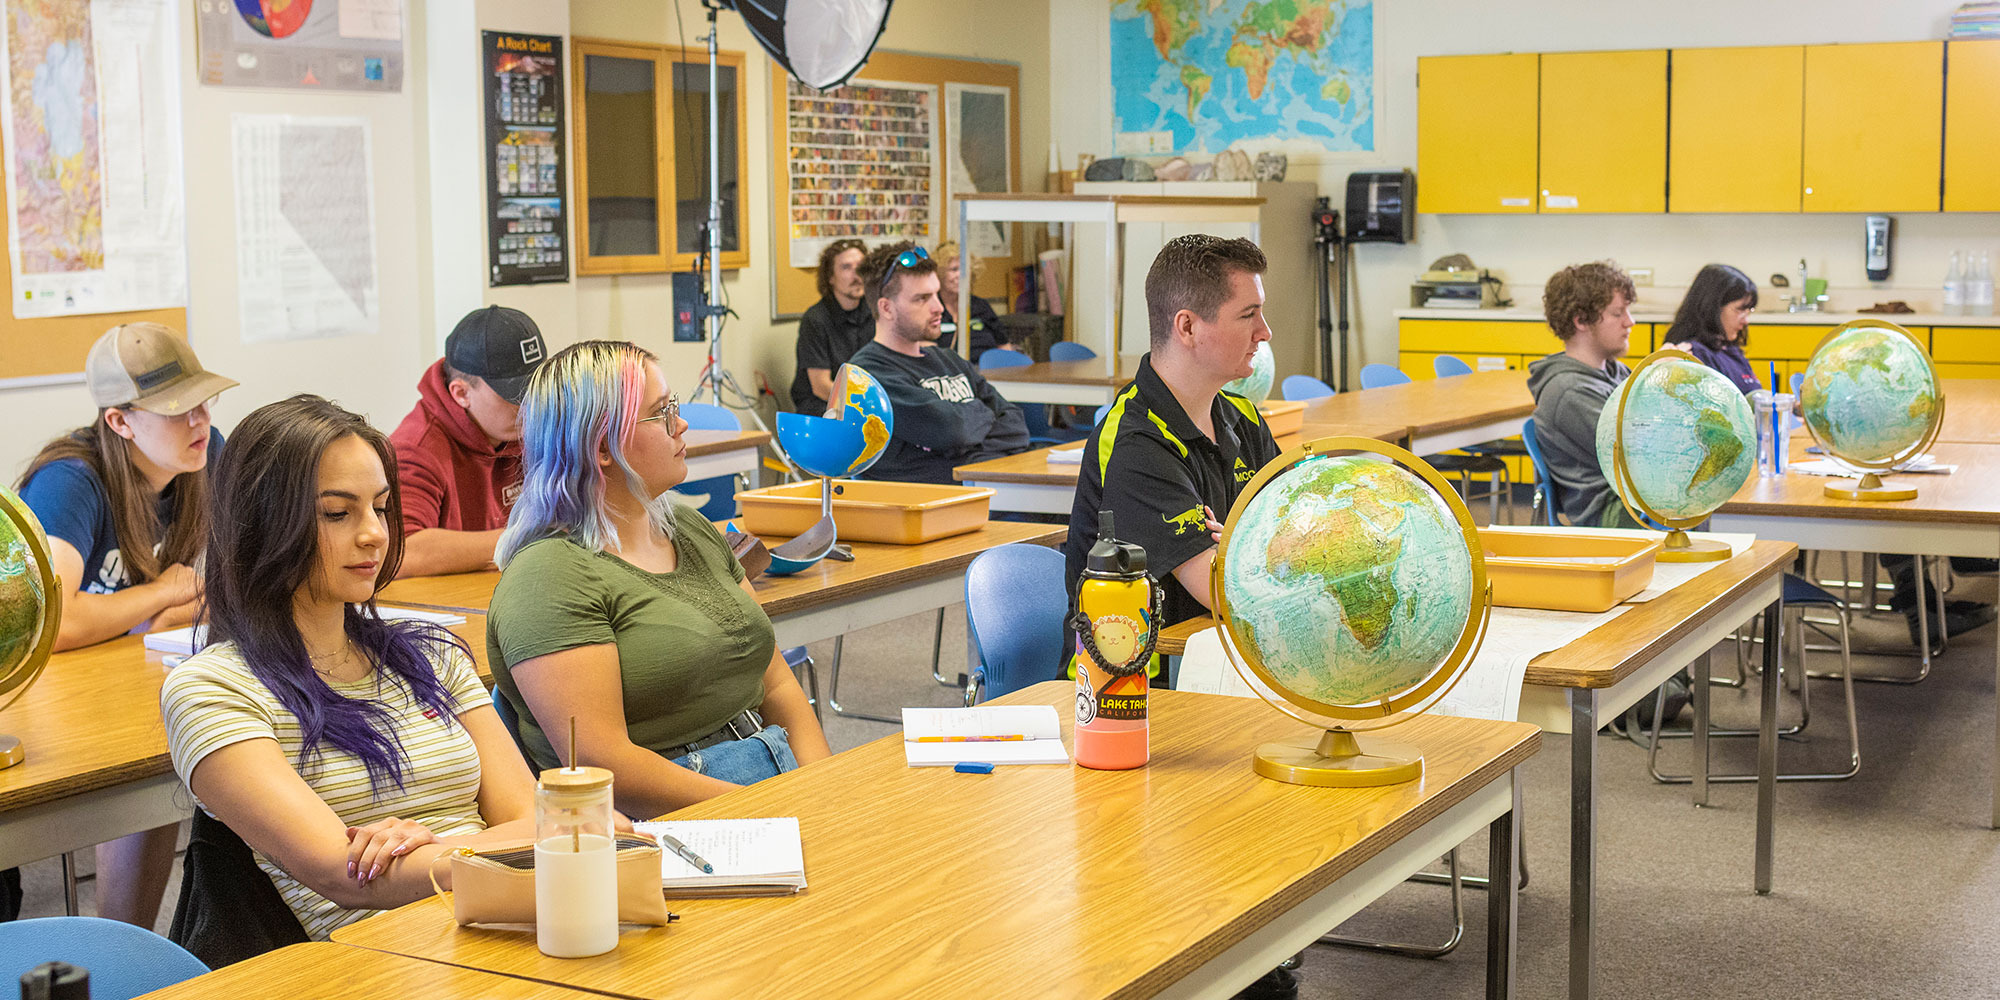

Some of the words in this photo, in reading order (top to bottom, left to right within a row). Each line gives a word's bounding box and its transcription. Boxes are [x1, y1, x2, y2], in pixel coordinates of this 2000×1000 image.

[497, 37, 504, 49] A
[505, 37, 528, 51] Rock
[529, 39, 552, 53] Chart
[1101, 698, 1127, 709] LAKE
